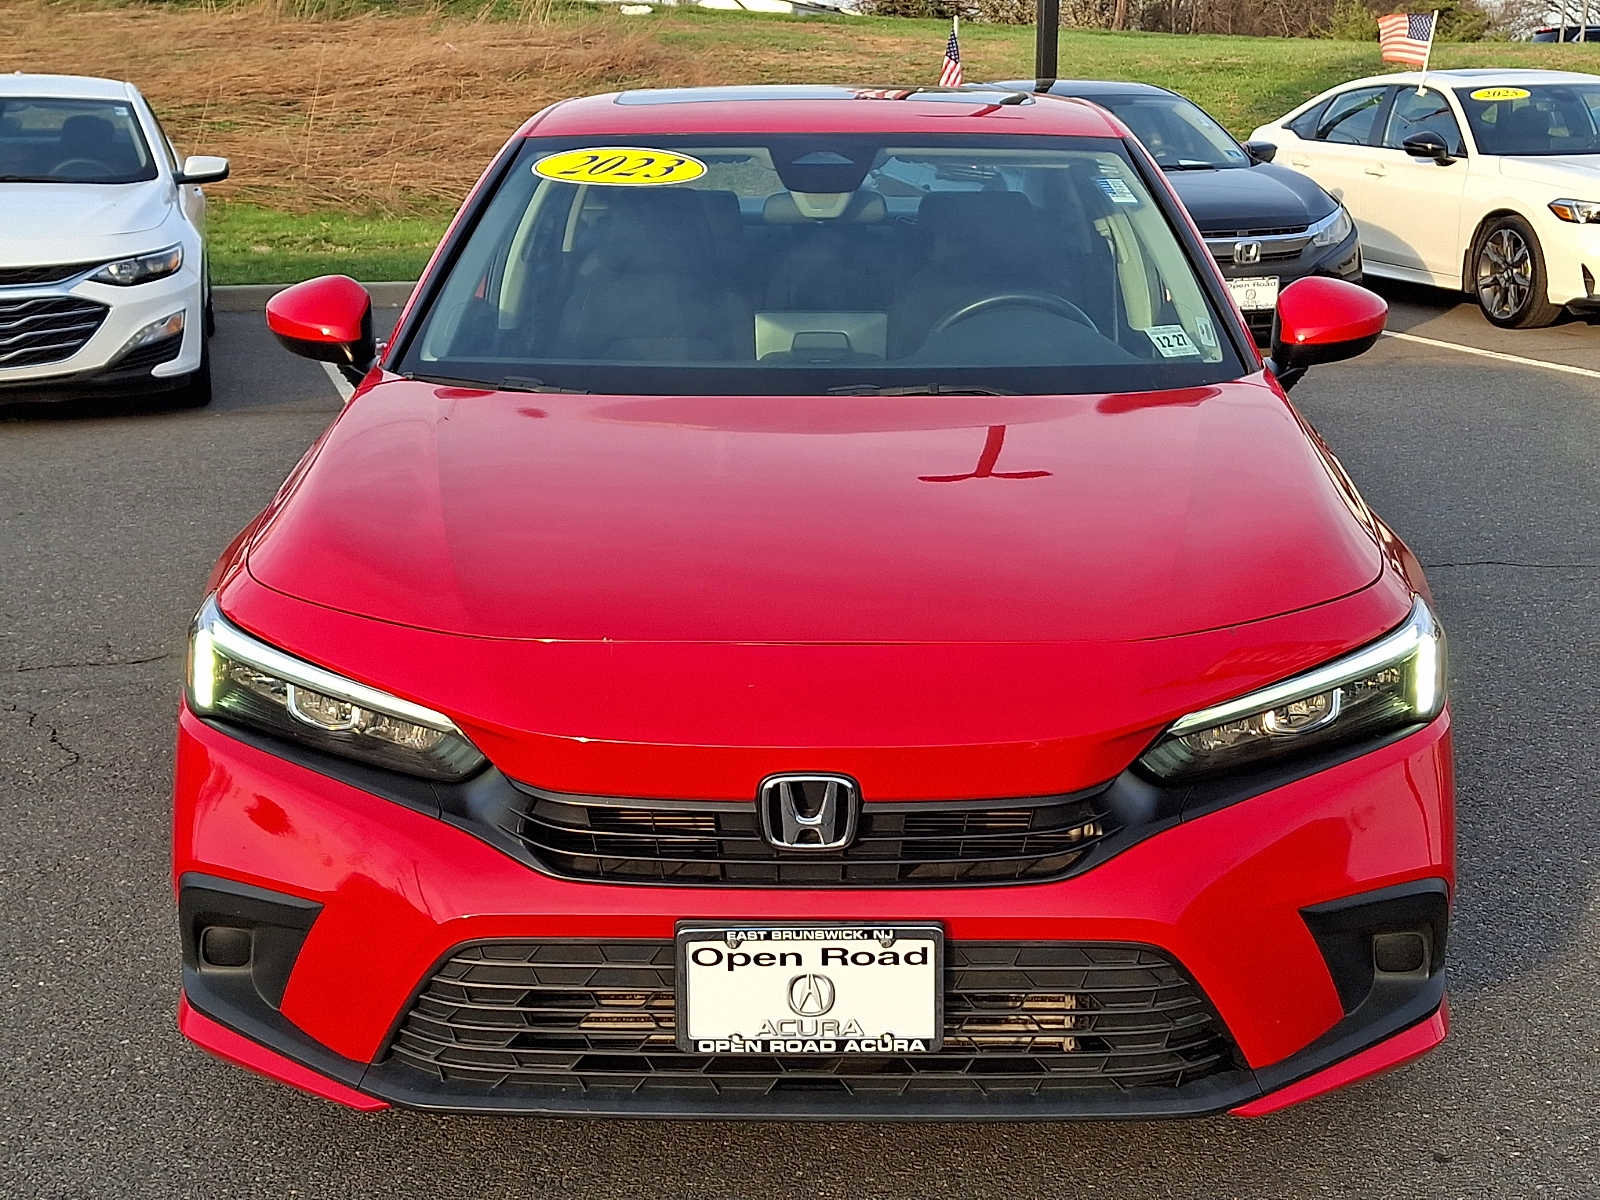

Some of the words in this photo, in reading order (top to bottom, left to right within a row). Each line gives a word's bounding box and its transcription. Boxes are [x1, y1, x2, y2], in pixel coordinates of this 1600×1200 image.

[557, 155, 686, 178] 2023
[726, 930, 767, 941] EAST
[771, 930, 868, 940] BRUNSWICK,
[873, 930, 894, 940] NJ
[691, 947, 803, 971] Open
[821, 946, 928, 967] Road
[755, 1018, 864, 1037] ACURA
[698, 1039, 762, 1053] OPEN
[770, 1039, 836, 1052] ROAD
[843, 1039, 926, 1052] ACURA
